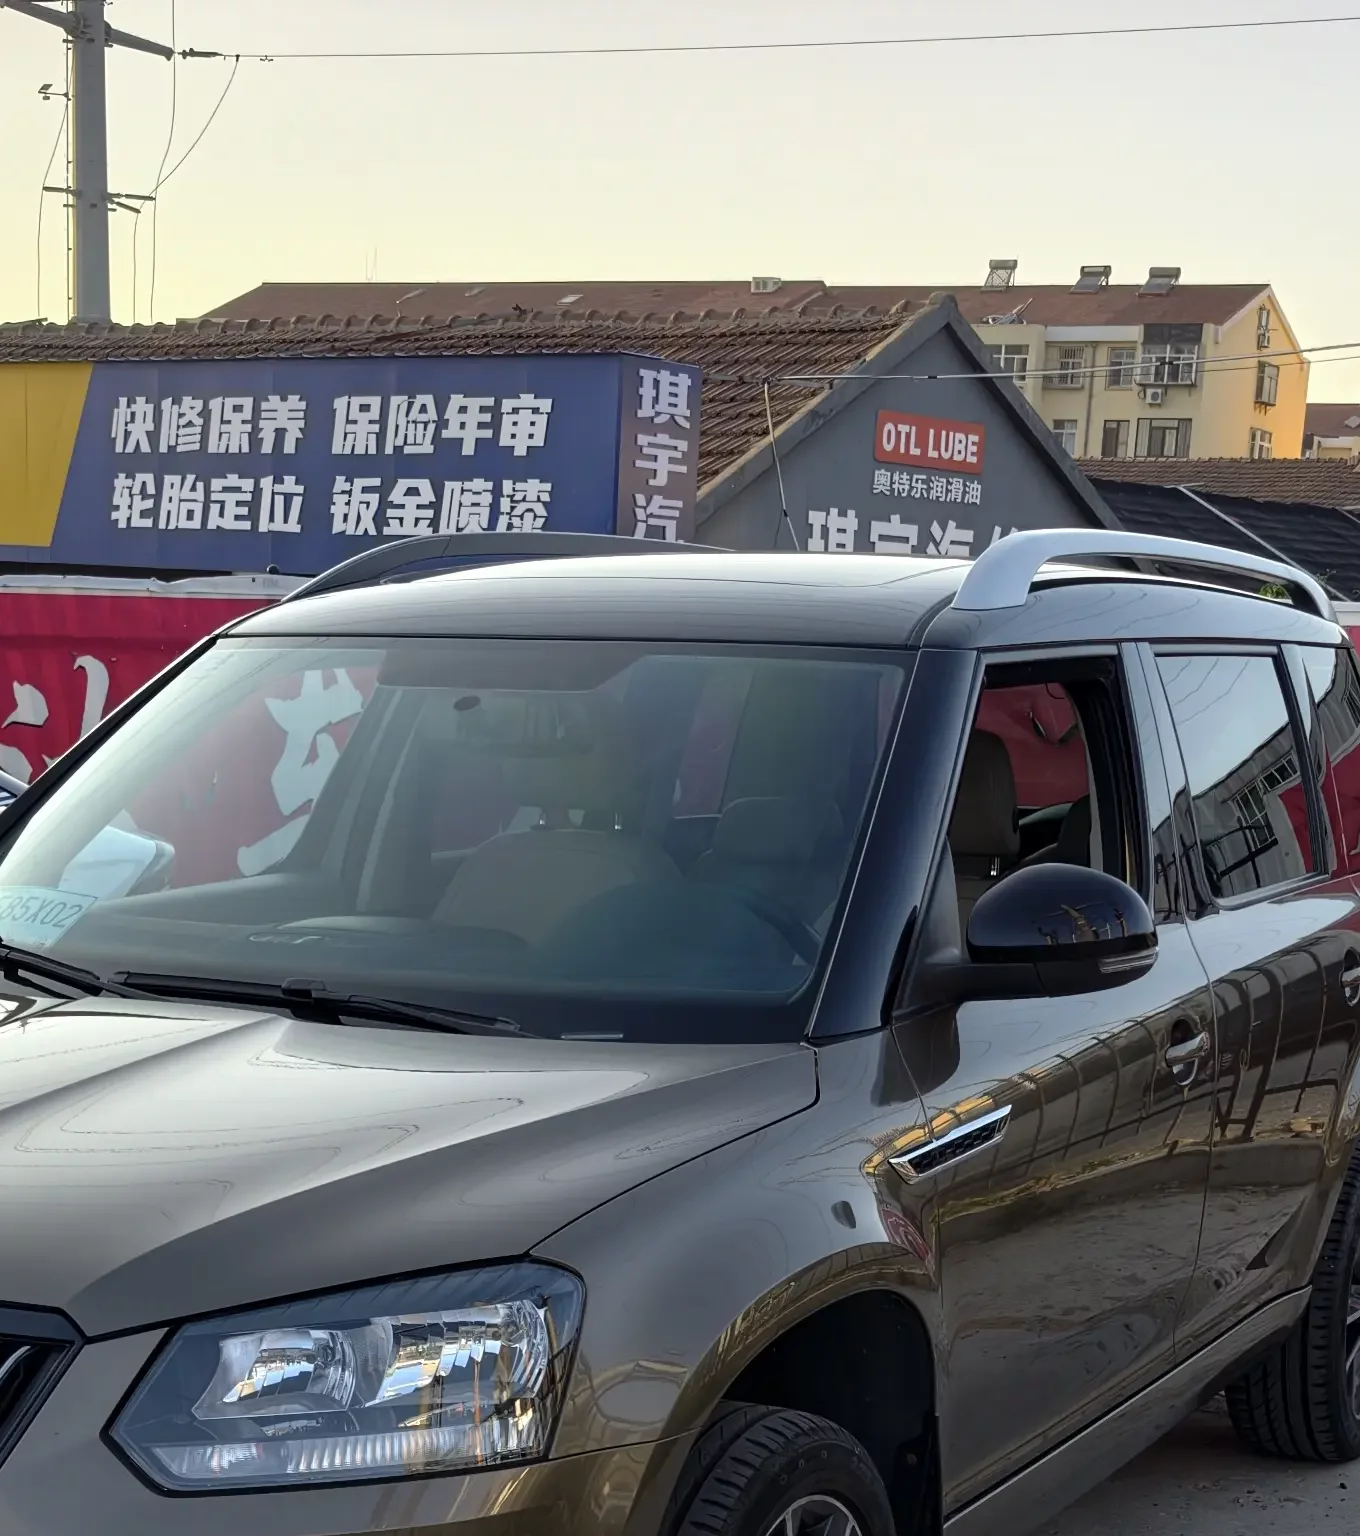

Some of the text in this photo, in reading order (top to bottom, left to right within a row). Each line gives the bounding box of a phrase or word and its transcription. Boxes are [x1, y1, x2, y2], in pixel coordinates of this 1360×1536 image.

[111, 394, 552, 456] 快修保养 保险年审
[882, 422, 980, 463] OTL LUBE
[111, 473, 552, 536] 轮胎定位 钣金喷漆
[872, 468, 982, 506] 奥特乐润滑油
